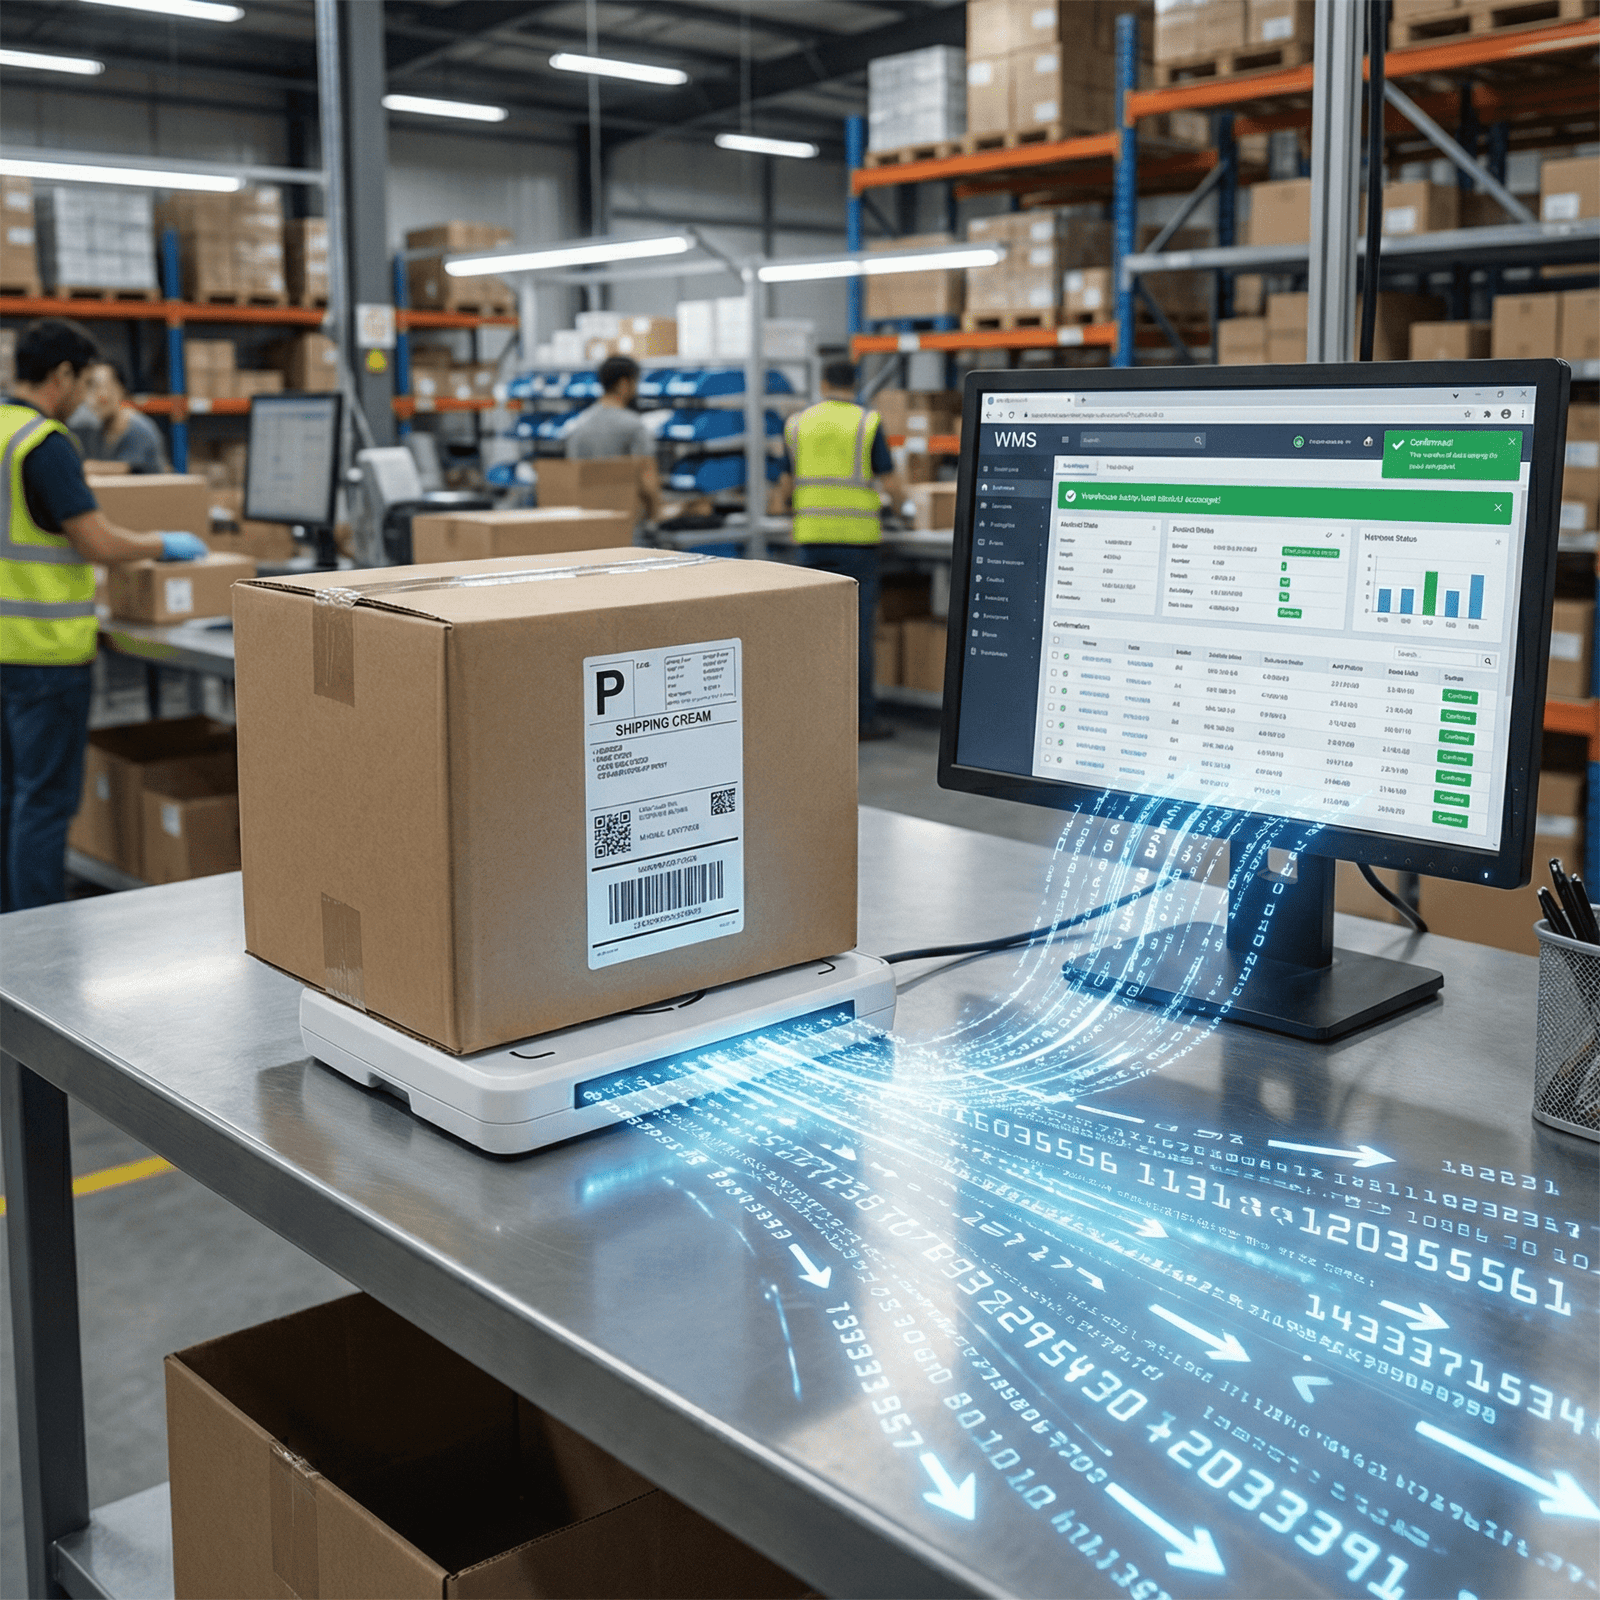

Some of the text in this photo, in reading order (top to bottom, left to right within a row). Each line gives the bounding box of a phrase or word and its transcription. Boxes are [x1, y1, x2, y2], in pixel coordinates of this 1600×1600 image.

[994, 431, 1037, 448] WMS
[596, 669, 625, 716] P
[615, 710, 712, 737] SHIPPING CREAM
[1441, 1160, 1560, 1196] 182231
